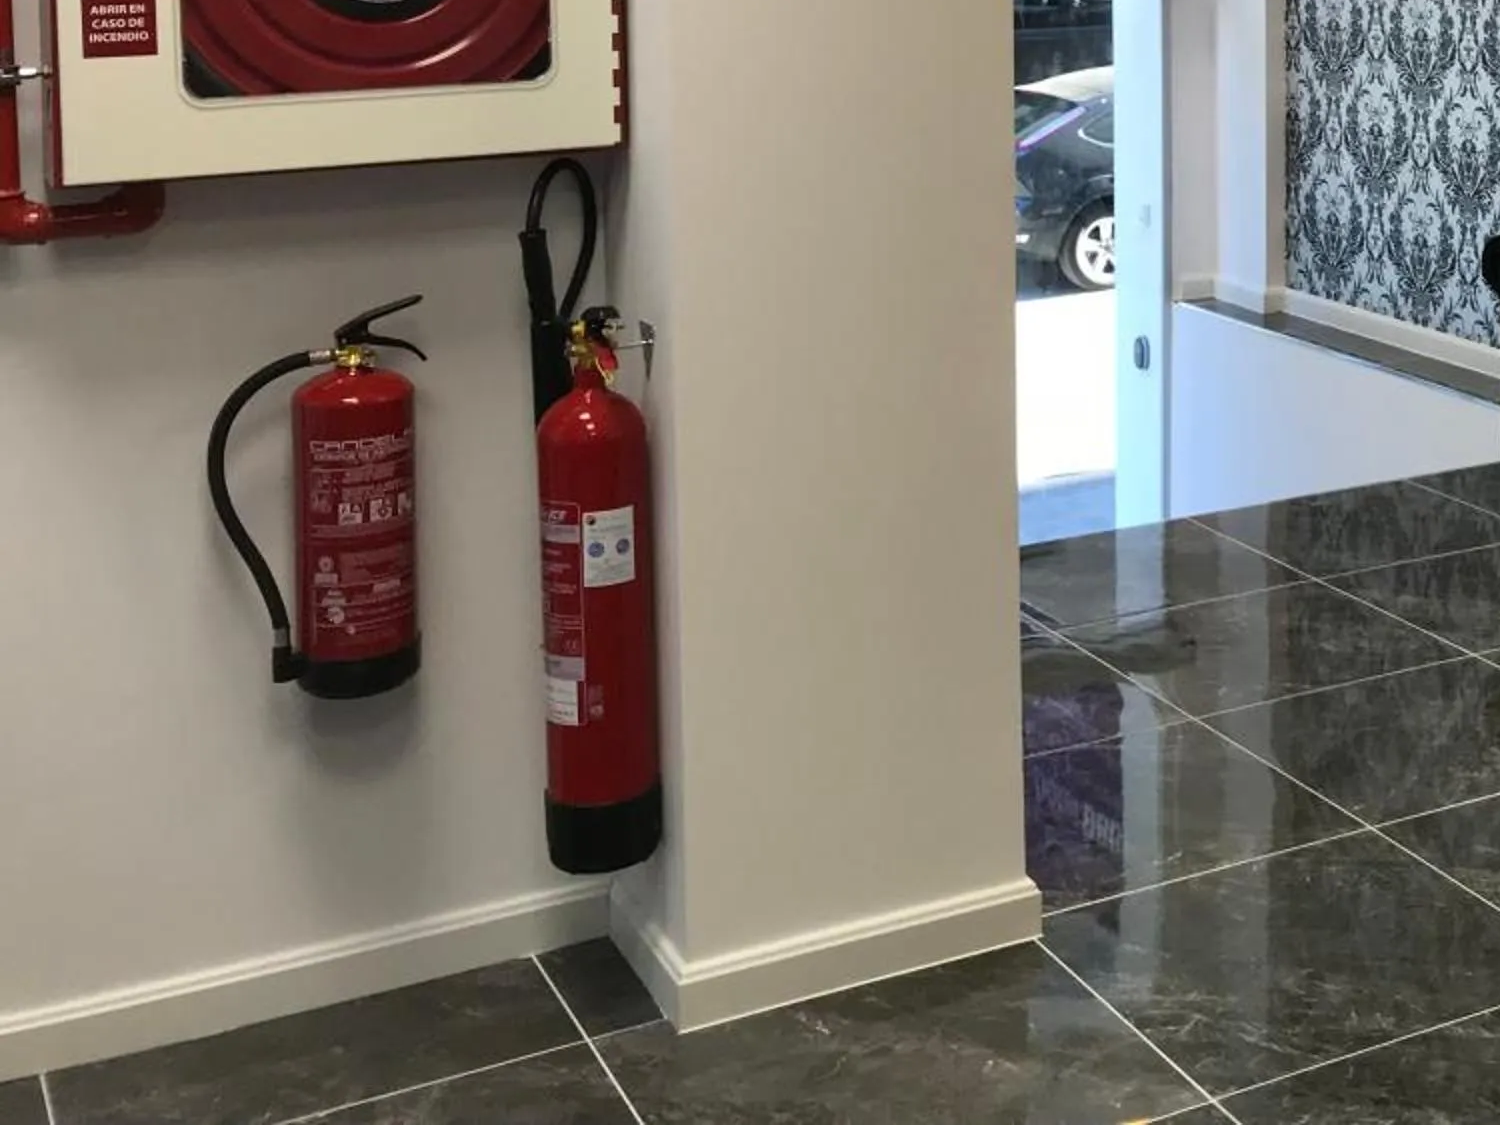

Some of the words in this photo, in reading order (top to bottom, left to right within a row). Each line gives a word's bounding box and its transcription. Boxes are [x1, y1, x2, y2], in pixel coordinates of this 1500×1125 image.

[90, 3, 127, 16] ABRIR
[129, 2, 145, 14] EN
[91, 18, 127, 30] CASO
[127, 16, 145, 28] DE
[89, 30, 149, 44] INCENDIO
